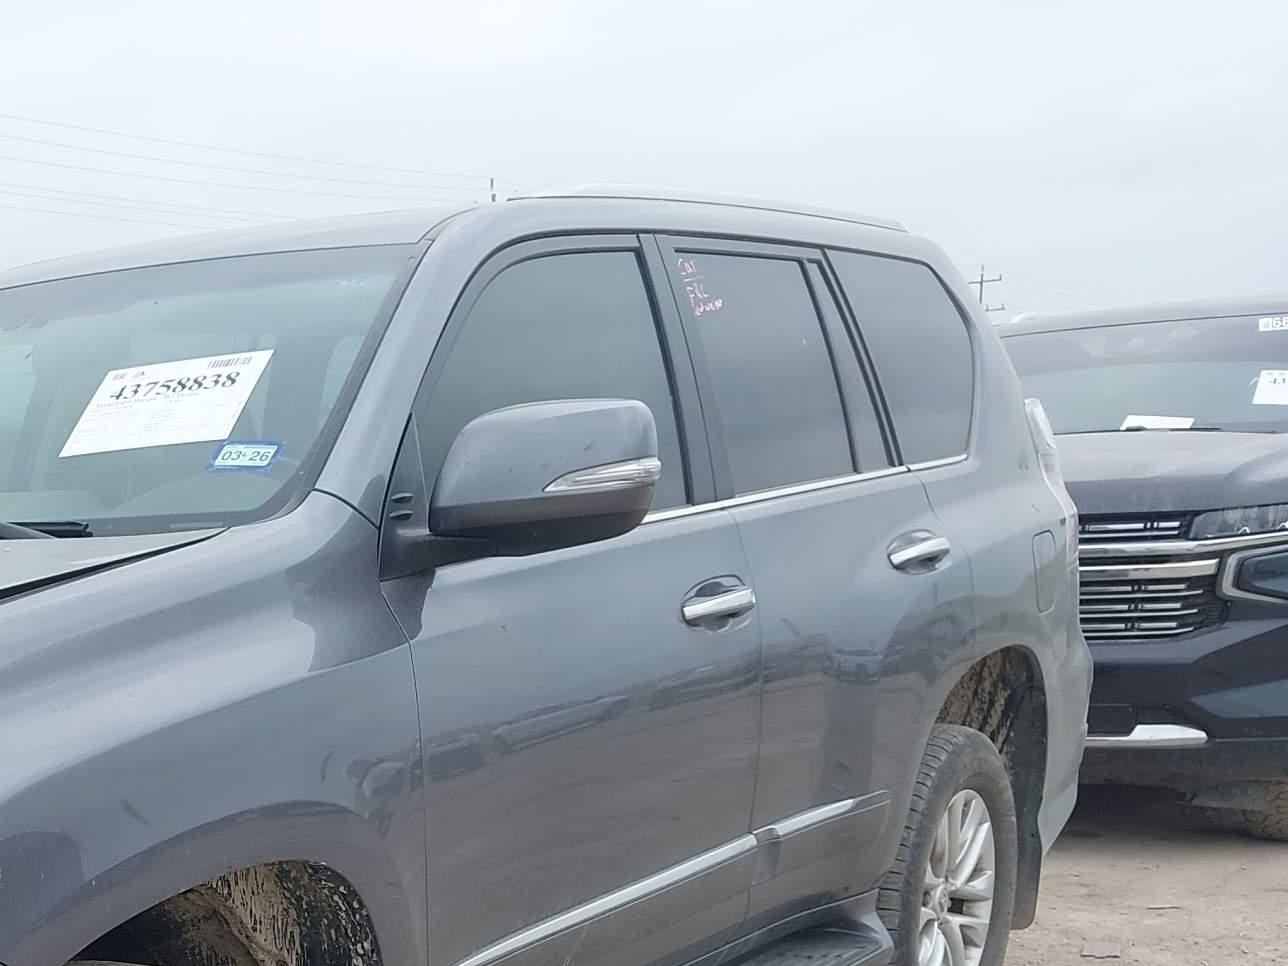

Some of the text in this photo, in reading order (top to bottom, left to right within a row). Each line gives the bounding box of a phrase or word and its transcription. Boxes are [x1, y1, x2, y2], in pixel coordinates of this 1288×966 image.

[109, 371, 241, 400] 43758838
[221, 450, 271, 462] 03 26
